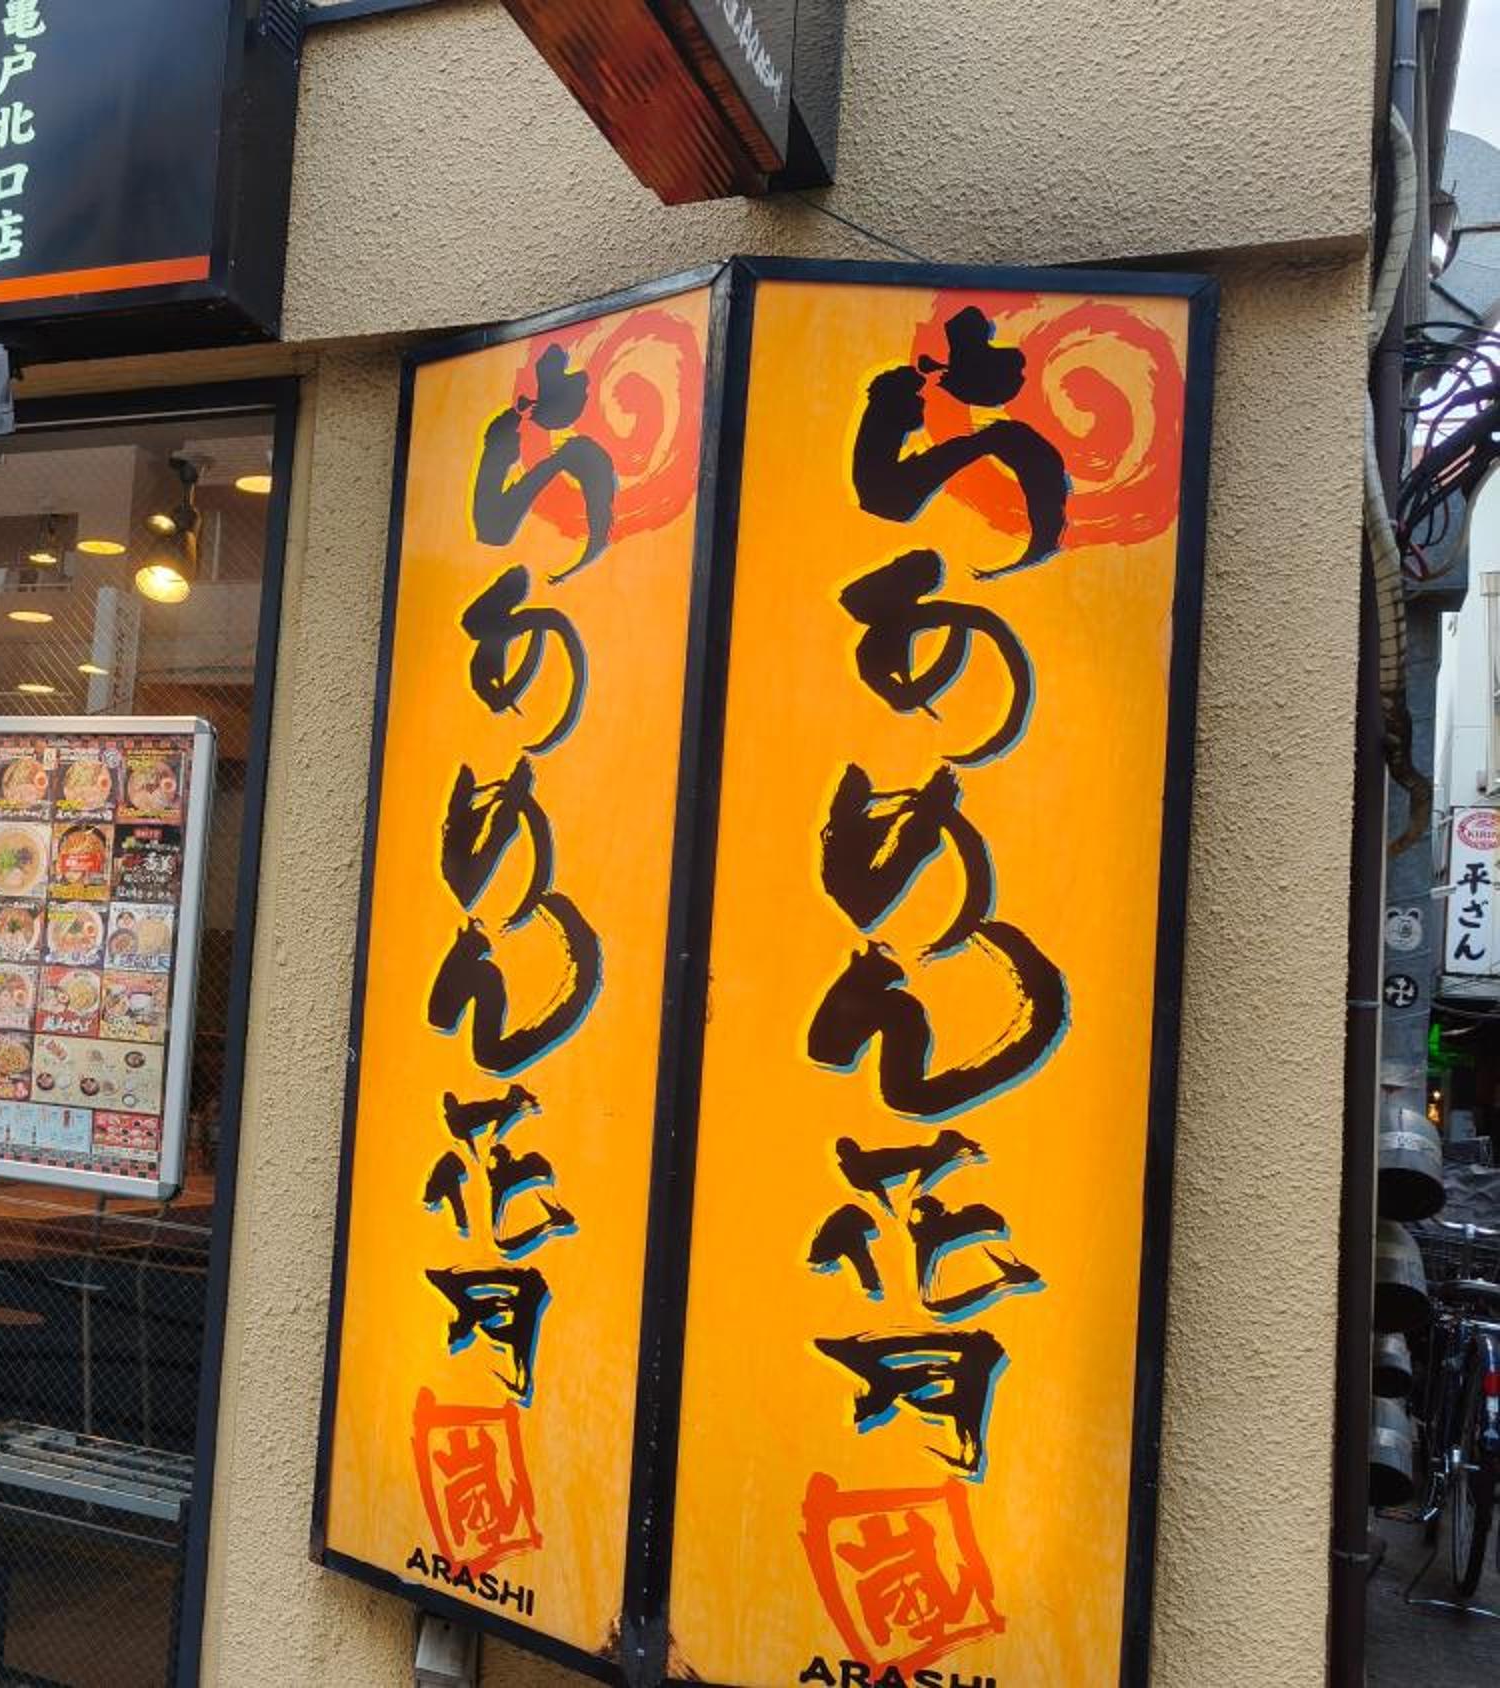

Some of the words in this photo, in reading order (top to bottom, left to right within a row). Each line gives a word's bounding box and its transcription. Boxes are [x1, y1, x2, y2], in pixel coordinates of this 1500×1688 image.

[1453, 861, 1492, 961] 平ざん
[405, 1546, 535, 1616] ARASHI
